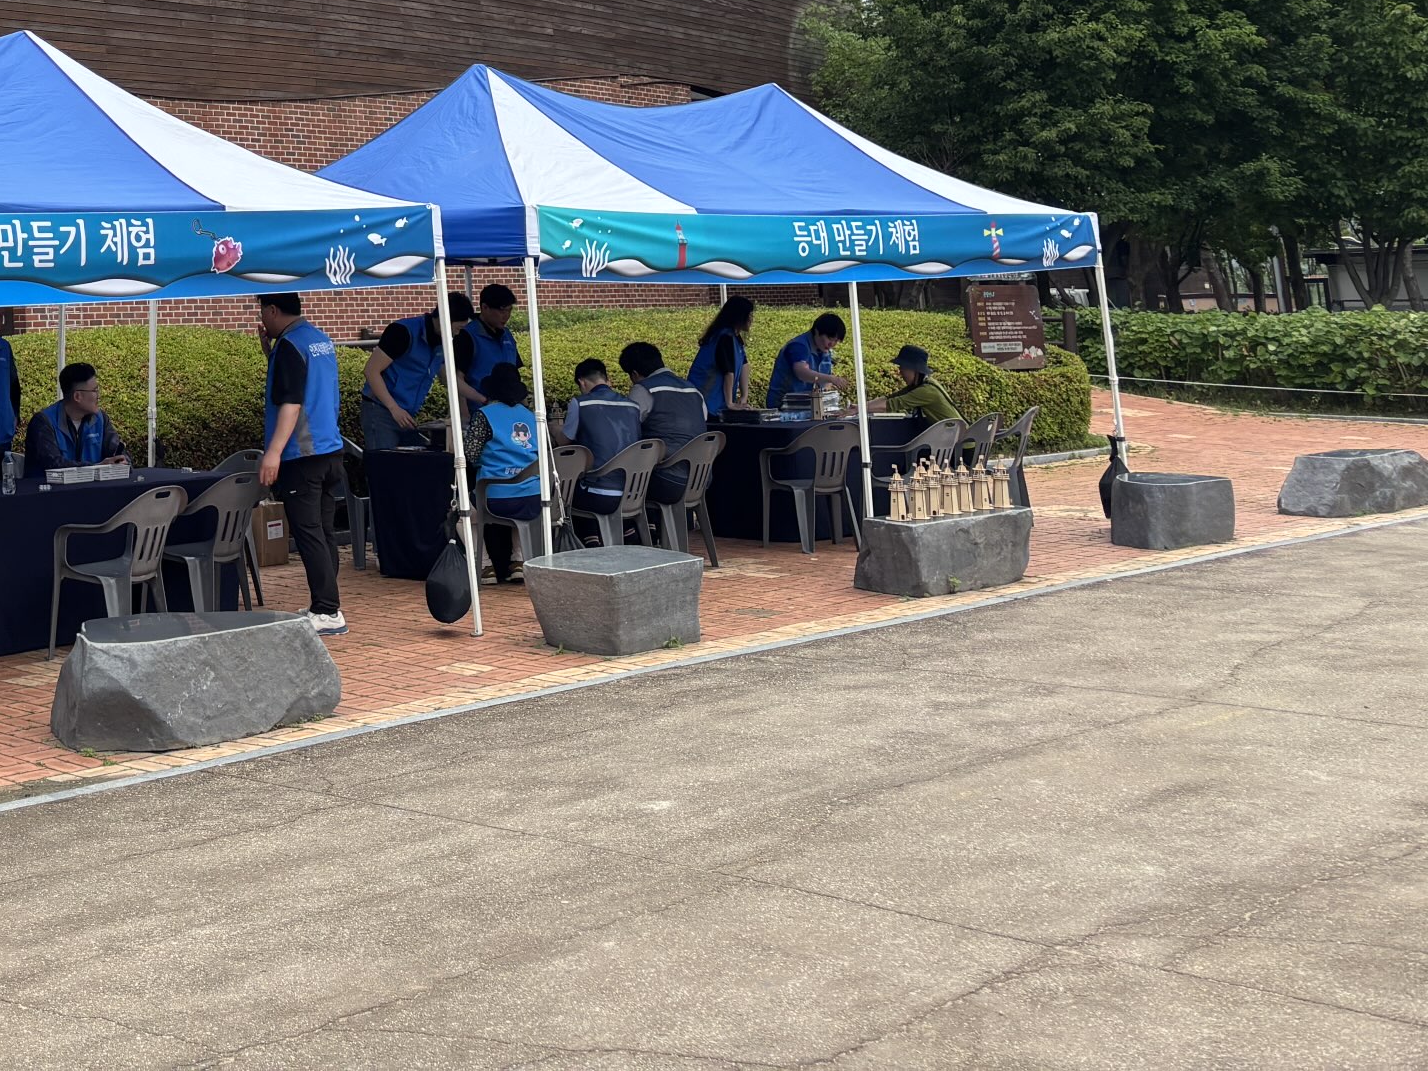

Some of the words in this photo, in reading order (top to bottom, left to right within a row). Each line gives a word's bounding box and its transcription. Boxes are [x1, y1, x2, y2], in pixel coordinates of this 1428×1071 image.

[100, 217, 155, 267] 체험
[792, 219, 829, 257] 등대
[831, 219, 883, 256] 만들기
[888, 219, 920, 255] 체험
